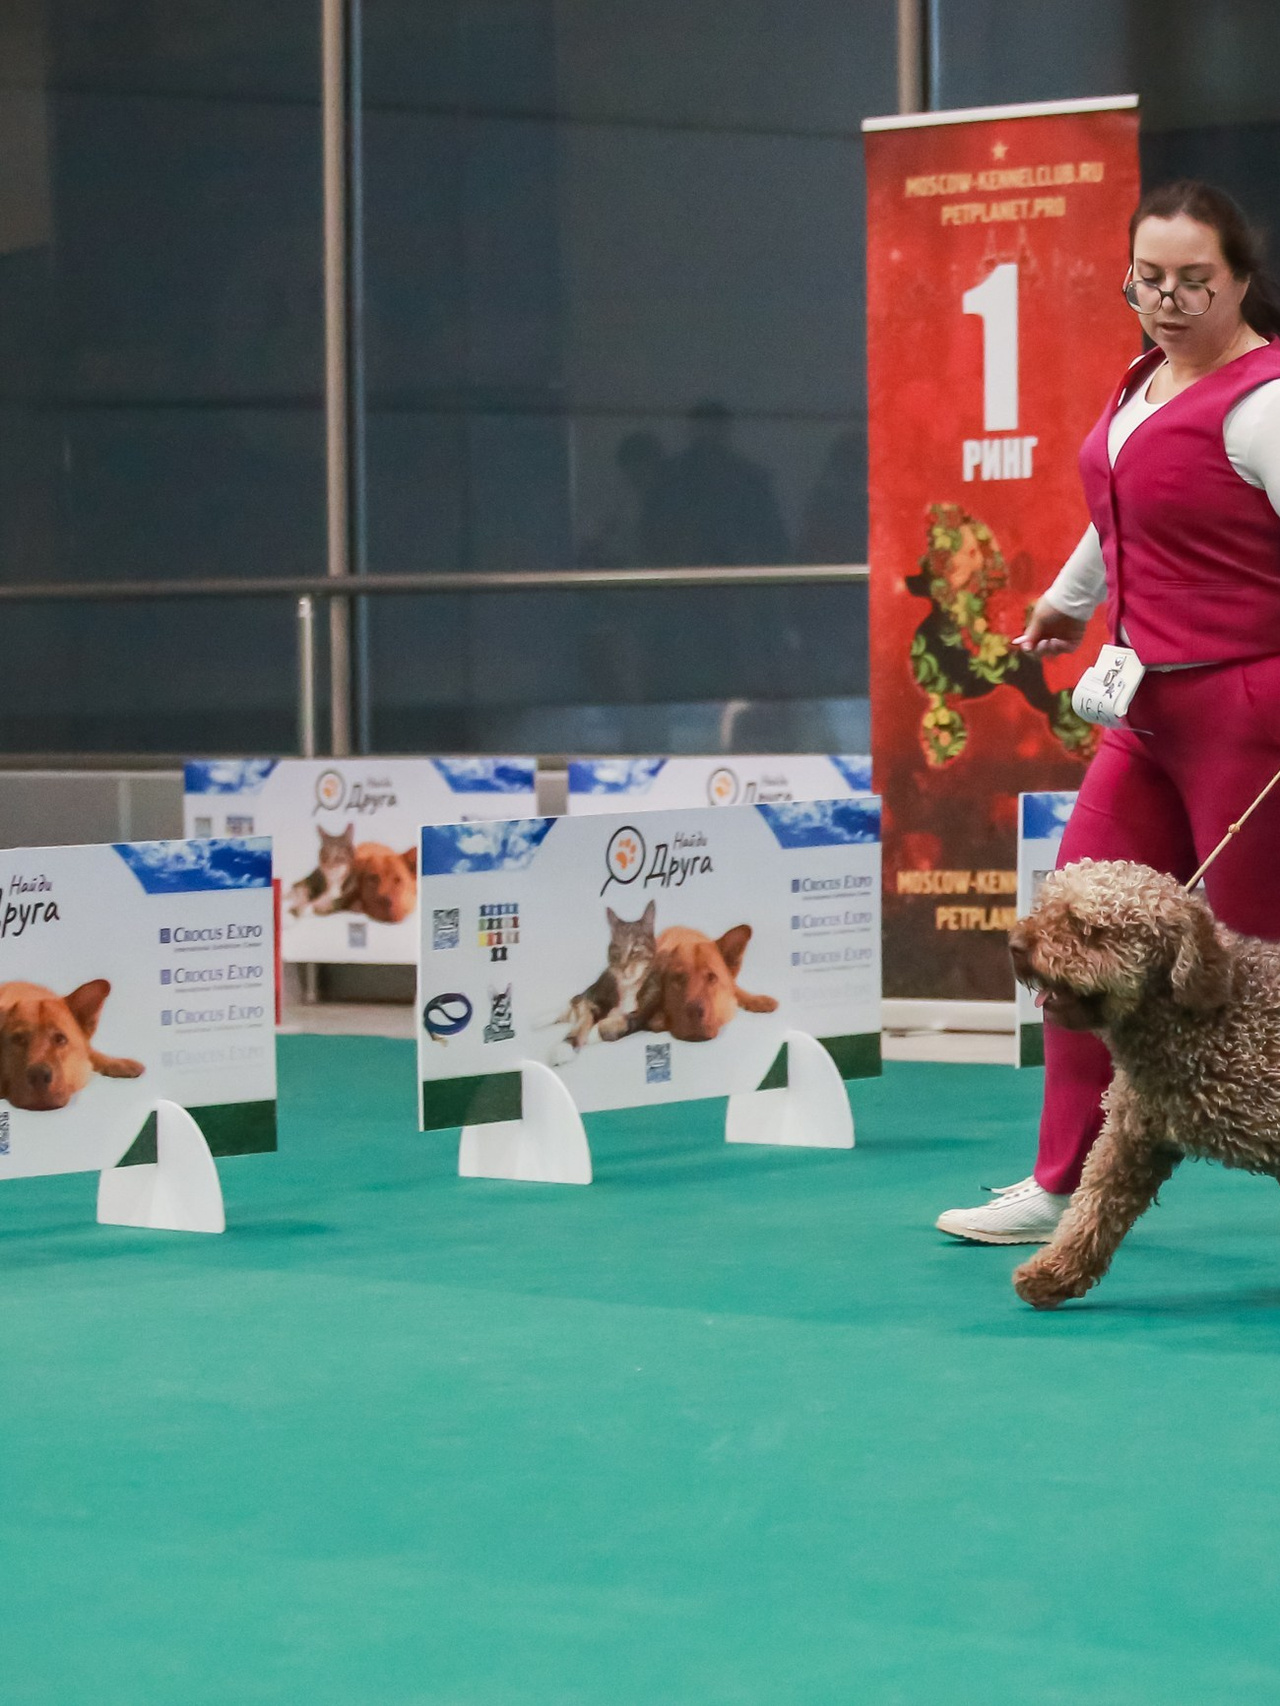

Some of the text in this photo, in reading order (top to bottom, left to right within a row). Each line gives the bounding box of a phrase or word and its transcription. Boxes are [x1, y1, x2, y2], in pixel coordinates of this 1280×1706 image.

[905, 161, 1104, 198] MOSCOW-KENNELCLUB.RU
[941, 195, 1067, 227] PETPLANET.PRO
[962, 262, 1019, 432] 1
[962, 435, 1039, 482] РИНГ
[643, 843, 714, 888] Друга
[9, 874, 53, 898] Найди
[0, 887, 60, 938] руга
[173, 923, 263, 943] CROCUS EXPO
[174, 964, 264, 984] CROCUS EXPO
[175, 1005, 264, 1025] CROCUS EXPO
